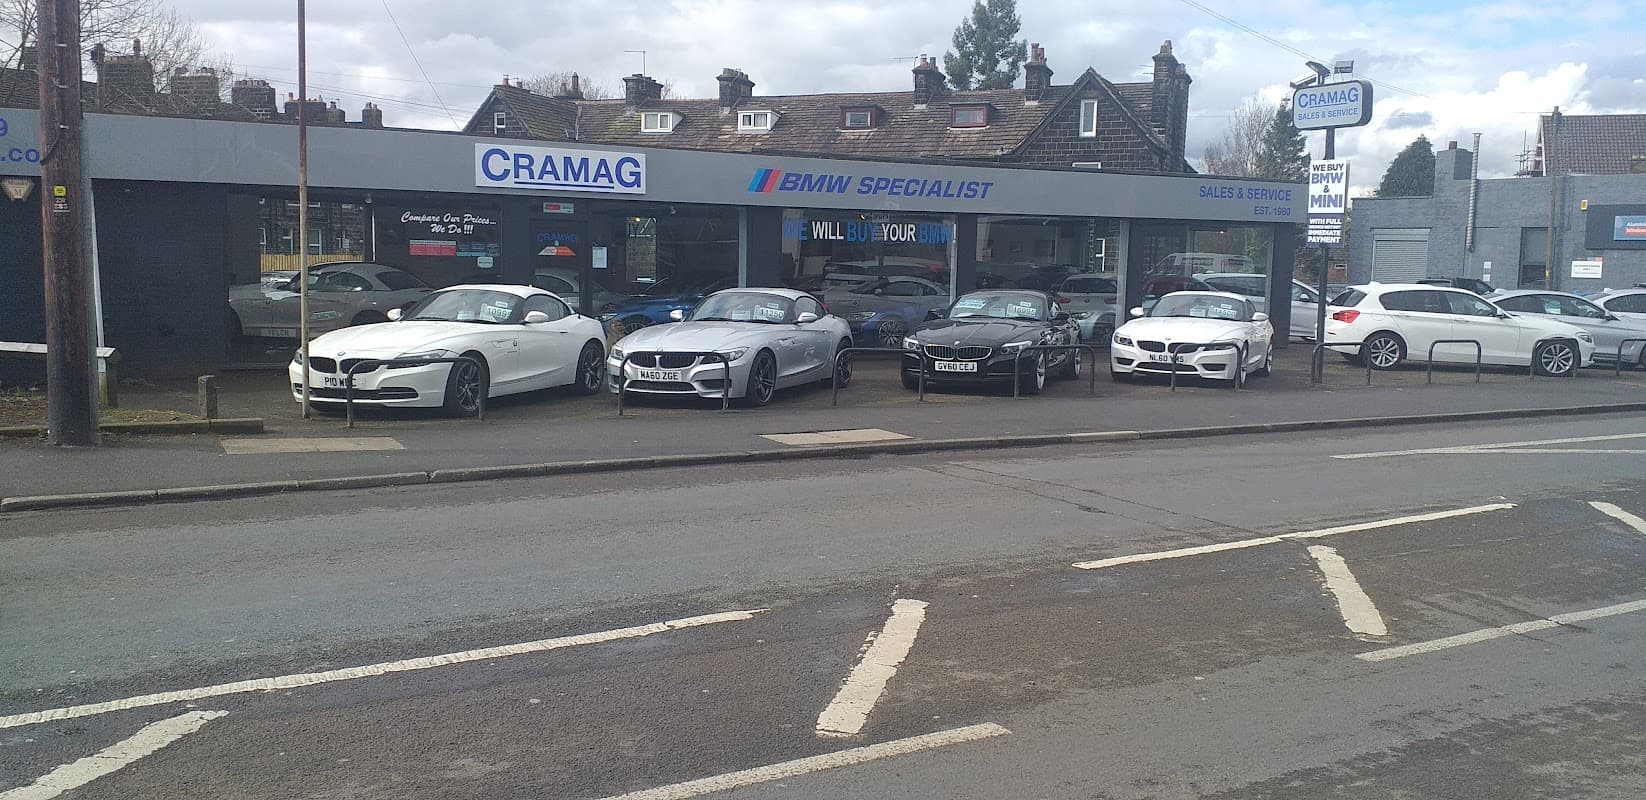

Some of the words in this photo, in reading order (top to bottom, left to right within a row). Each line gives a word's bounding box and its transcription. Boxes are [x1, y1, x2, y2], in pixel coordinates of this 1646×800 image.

[1298, 87, 1359, 108] CRAMAG
[1298, 111, 1320, 120] SALES
[1327, 107, 1358, 118] SERVICE
[482, 148, 641, 188] CRAMAG
[1312, 164, 1326, 172] WE
[1327, 163, 1344, 172] BUY
[1311, 172, 1343, 184] BMW
[778, 172, 852, 194] BMW
[857, 176, 993, 199] SPECIALIST
[1323, 184, 1330, 193] &
[1200, 185, 1234, 199] SALES
[1237, 187, 1243, 199] &
[1247, 188, 1291, 201] SERVICE
[1310, 194, 1343, 209] MINI
[1254, 205, 1271, 216] EST.
[1273, 207, 1291, 216] 1980
[401, 211, 440, 223] Compare
[443, 213, 460, 222] Our
[430, 223, 446, 233] We
[447, 224, 462, 234] Do
[784, 218, 808, 241] WE
[812, 220, 844, 240] WILL
[847, 221, 878, 242] BUY
[882, 222, 916, 242] YOUR
[662, 371, 680, 381] ZGE
